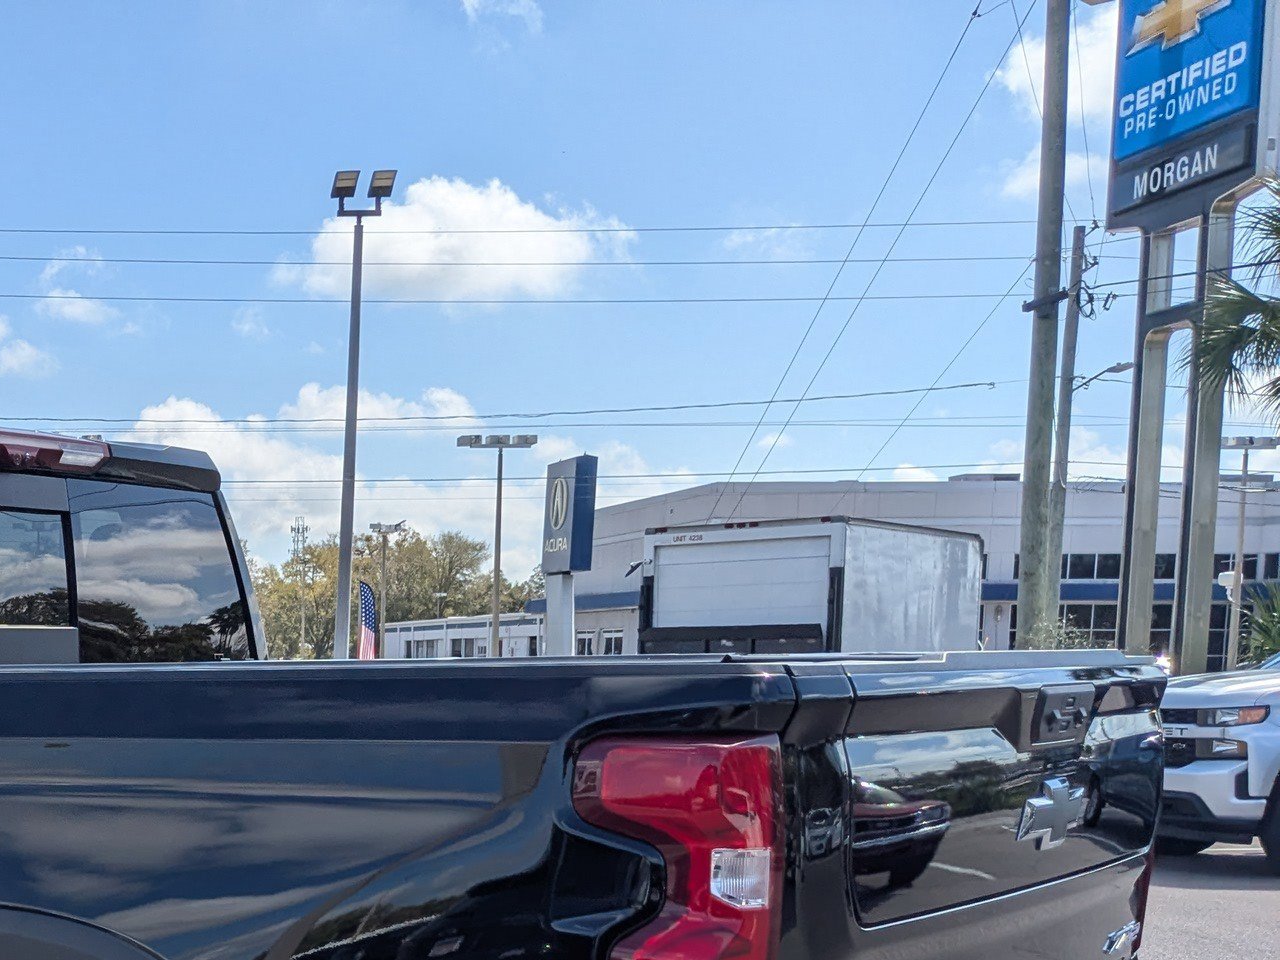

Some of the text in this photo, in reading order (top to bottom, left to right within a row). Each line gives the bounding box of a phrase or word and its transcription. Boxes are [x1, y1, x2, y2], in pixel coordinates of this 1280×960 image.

[1119, 41, 1248, 118] CERTIFIED
[1124, 72, 1238, 139] PRE-OWNED
[1133, 144, 1218, 200] MORGAN
[544, 537, 568, 553] ACURA
